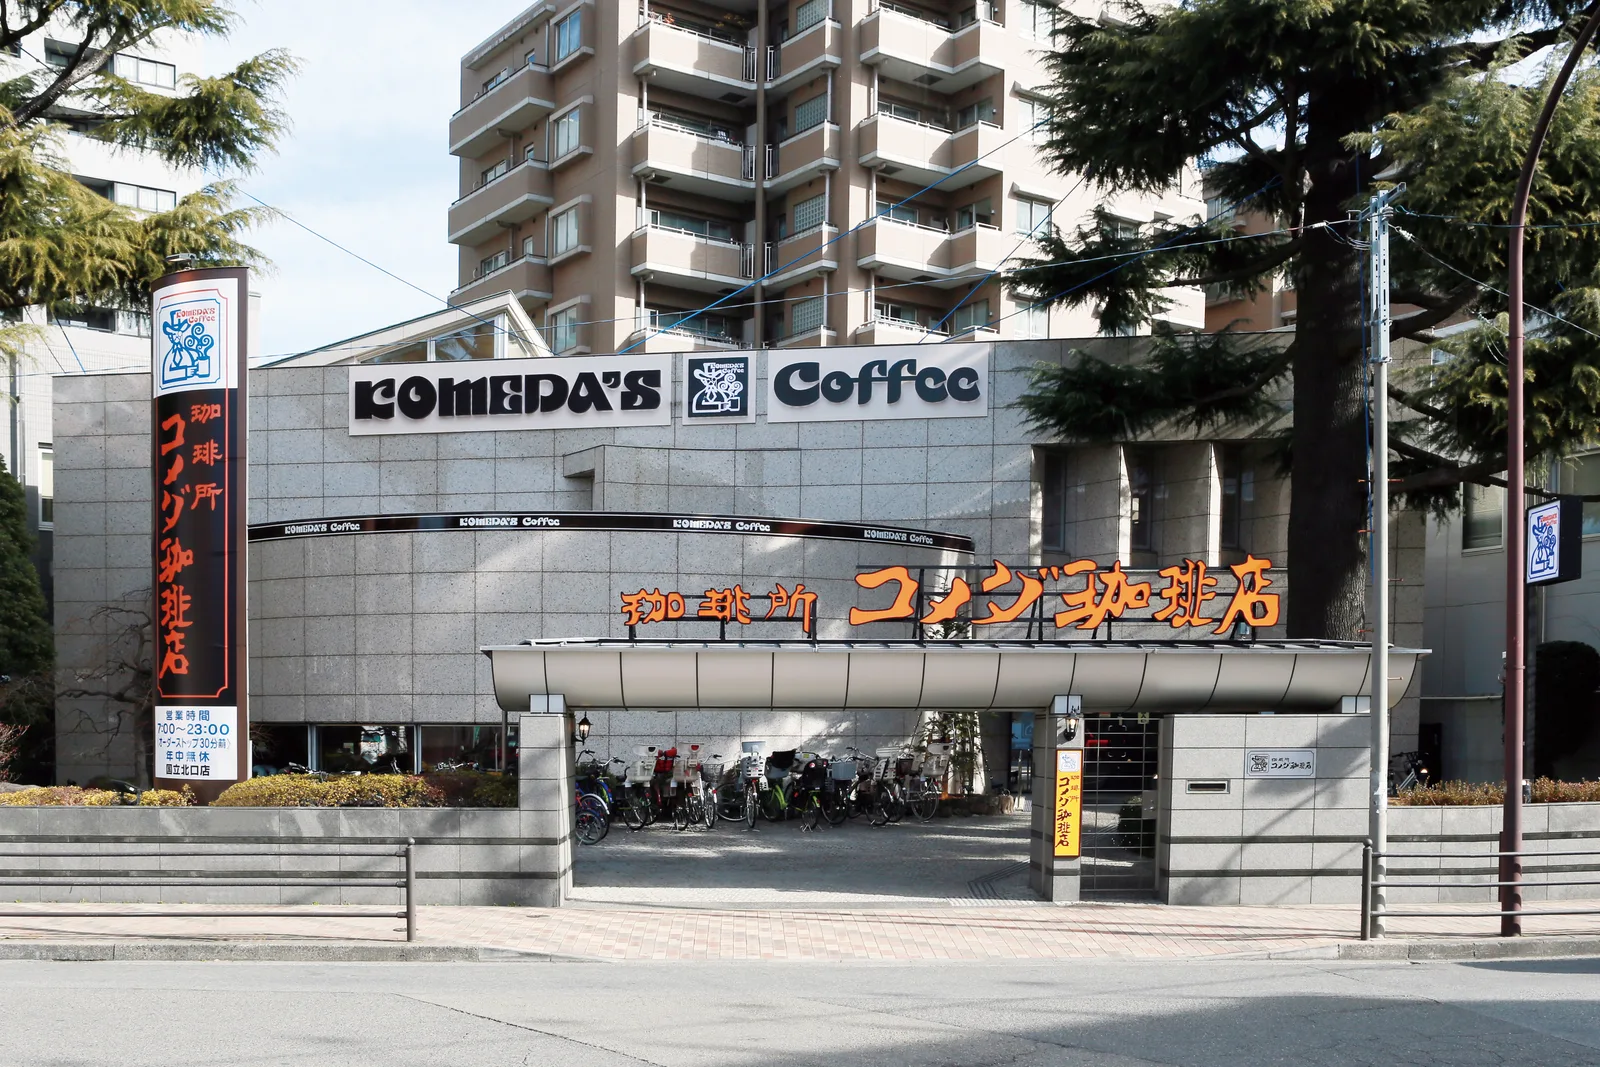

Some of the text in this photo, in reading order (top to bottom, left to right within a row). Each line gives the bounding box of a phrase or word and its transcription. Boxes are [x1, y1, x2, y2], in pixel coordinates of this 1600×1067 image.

[354, 358, 982, 420] KOMEDA'S Coffee
[190, 403, 223, 511] 珈琲所
[284, 522, 360, 534] KOMEDA'S Coffee
[459, 517, 560, 527] KOMEDA'S Coffee
[672, 519, 771, 532] KOMEDA'S Coffee
[864, 529, 934, 545] KOMEDA'S Coffee
[159, 413, 193, 679] コメダ珈琲店
[848, 554, 1281, 635] コメダ珈琲店
[620, 583, 819, 633] 珈琲所
[166, 710, 210, 721] 営業時間
[166, 751, 210, 762] 年中無休
[166, 764, 210, 776] 国立北口店
